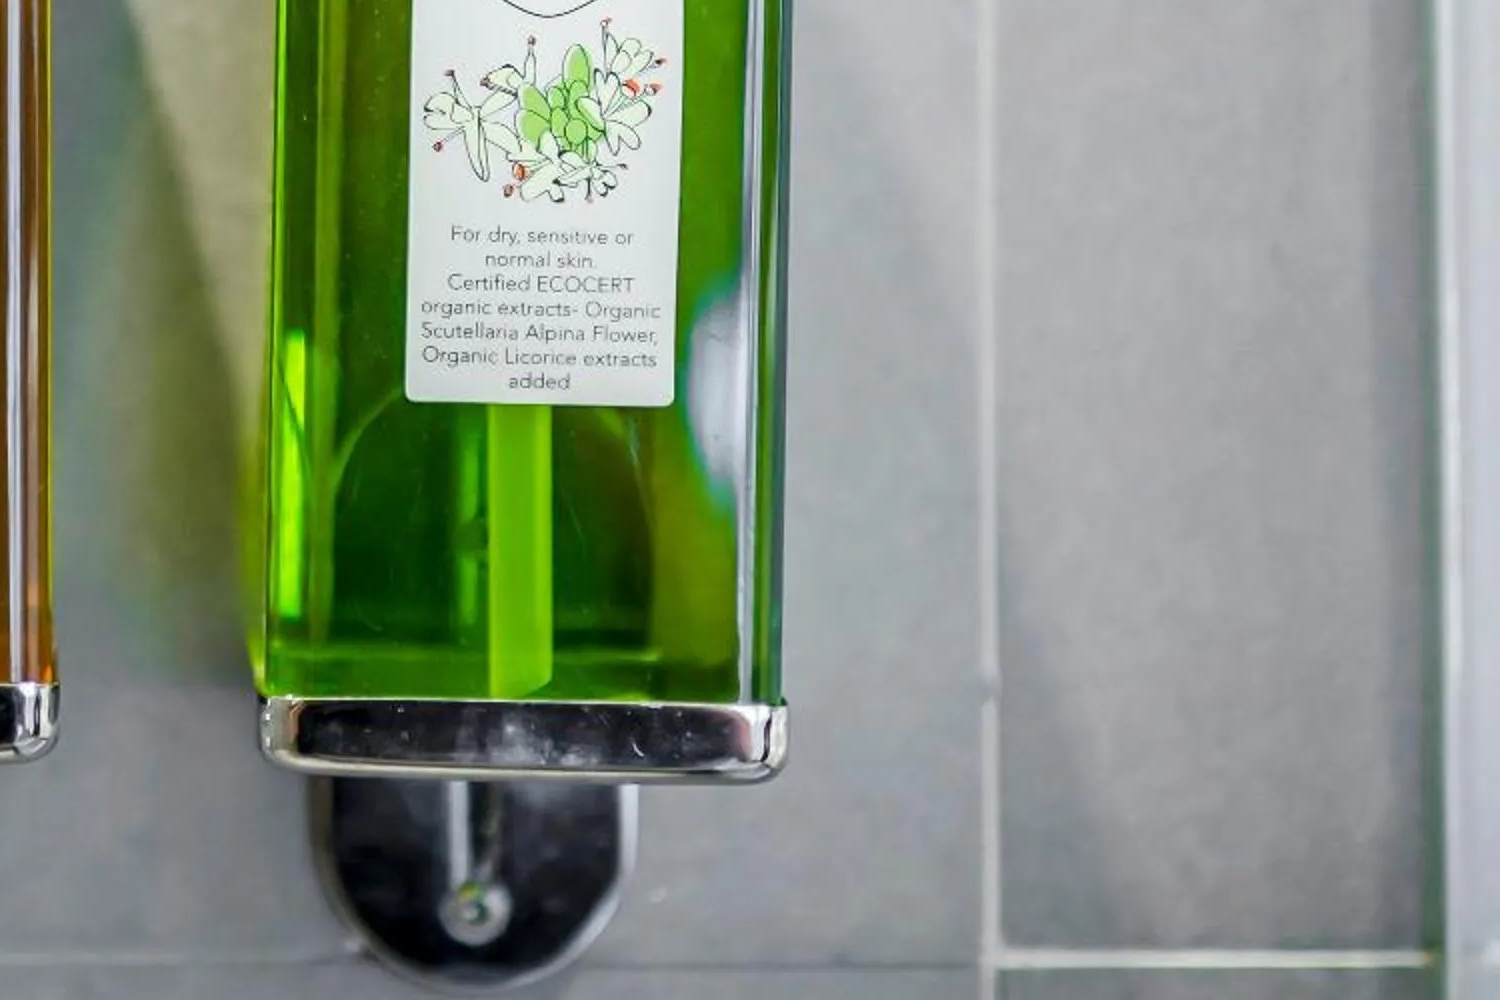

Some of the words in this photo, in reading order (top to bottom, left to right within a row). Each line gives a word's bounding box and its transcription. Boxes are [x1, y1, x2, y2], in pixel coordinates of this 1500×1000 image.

[450, 225, 480, 242] For
[527, 229, 608, 245] sensitive
[615, 233, 634, 245] or
[485, 252, 551, 268] normal
[448, 273, 531, 292] Certified
[537, 275, 635, 293] ECOCERT
[421, 301, 491, 319] organic
[497, 302, 578, 316] extracts-
[585, 301, 661, 322] Organic
[421, 321, 518, 340] Scutellaria
[525, 323, 585, 345] Alpina
[592, 325, 658, 346] Flower,
[422, 346, 499, 368] Organic
[504, 347, 577, 365] Licorice
[583, 351, 657, 367] extracts
[509, 372, 571, 390] added
